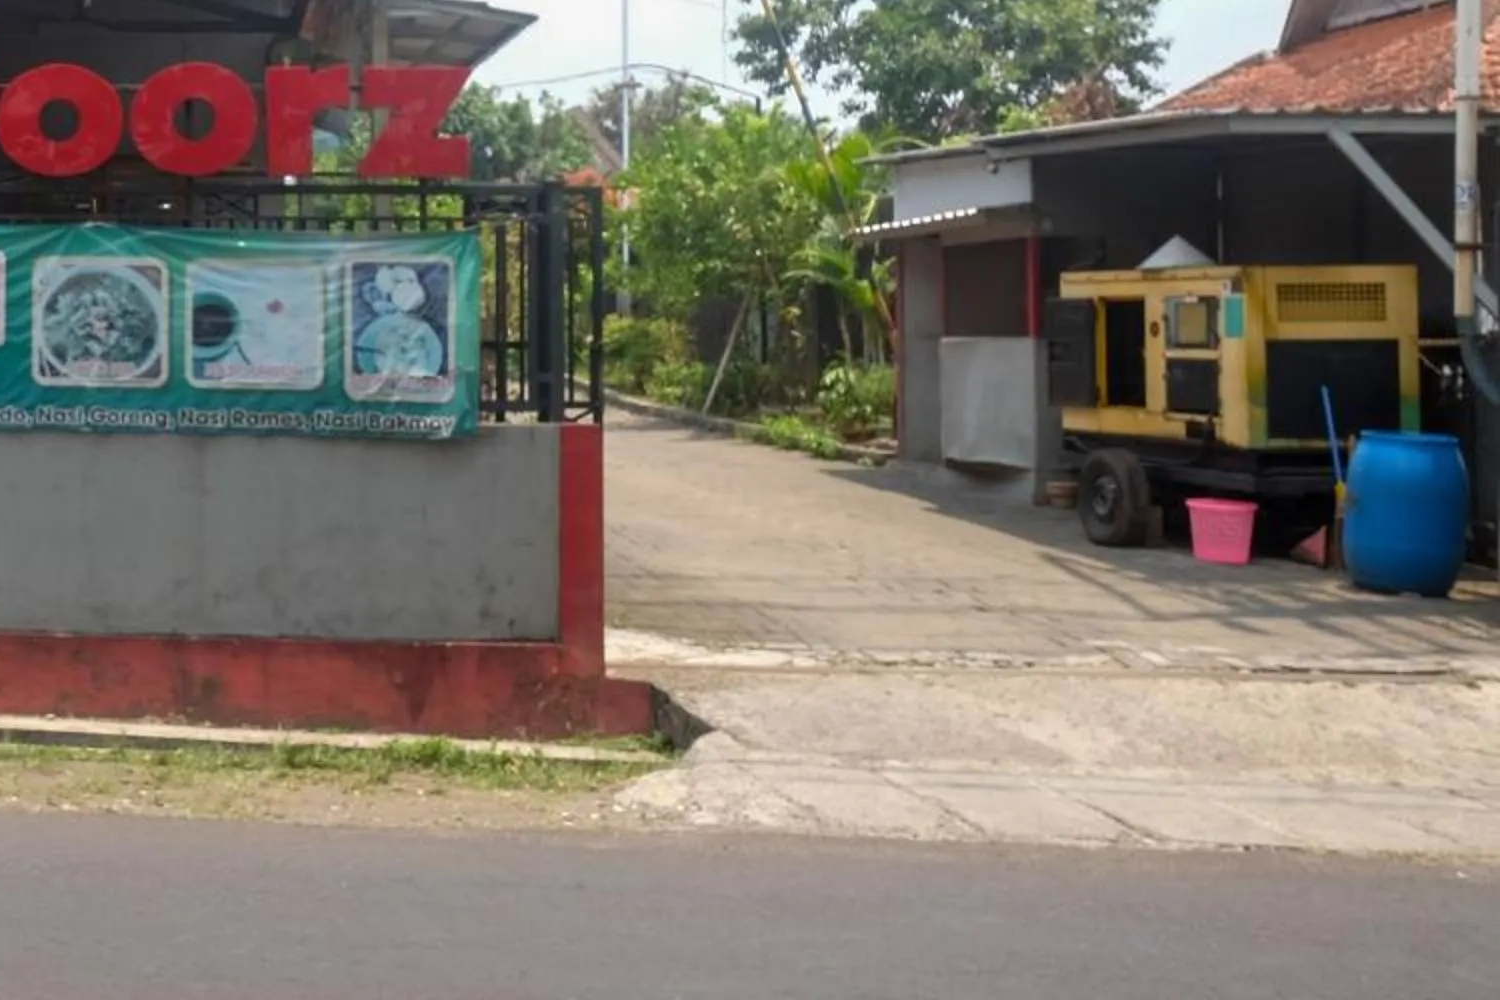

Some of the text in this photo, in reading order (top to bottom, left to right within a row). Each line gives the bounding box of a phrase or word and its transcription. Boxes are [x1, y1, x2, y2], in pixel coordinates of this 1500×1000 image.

[36, 405, 84, 425] Nasi
[178, 408, 226, 427] Nasi
[314, 409, 363, 430] Nasi
